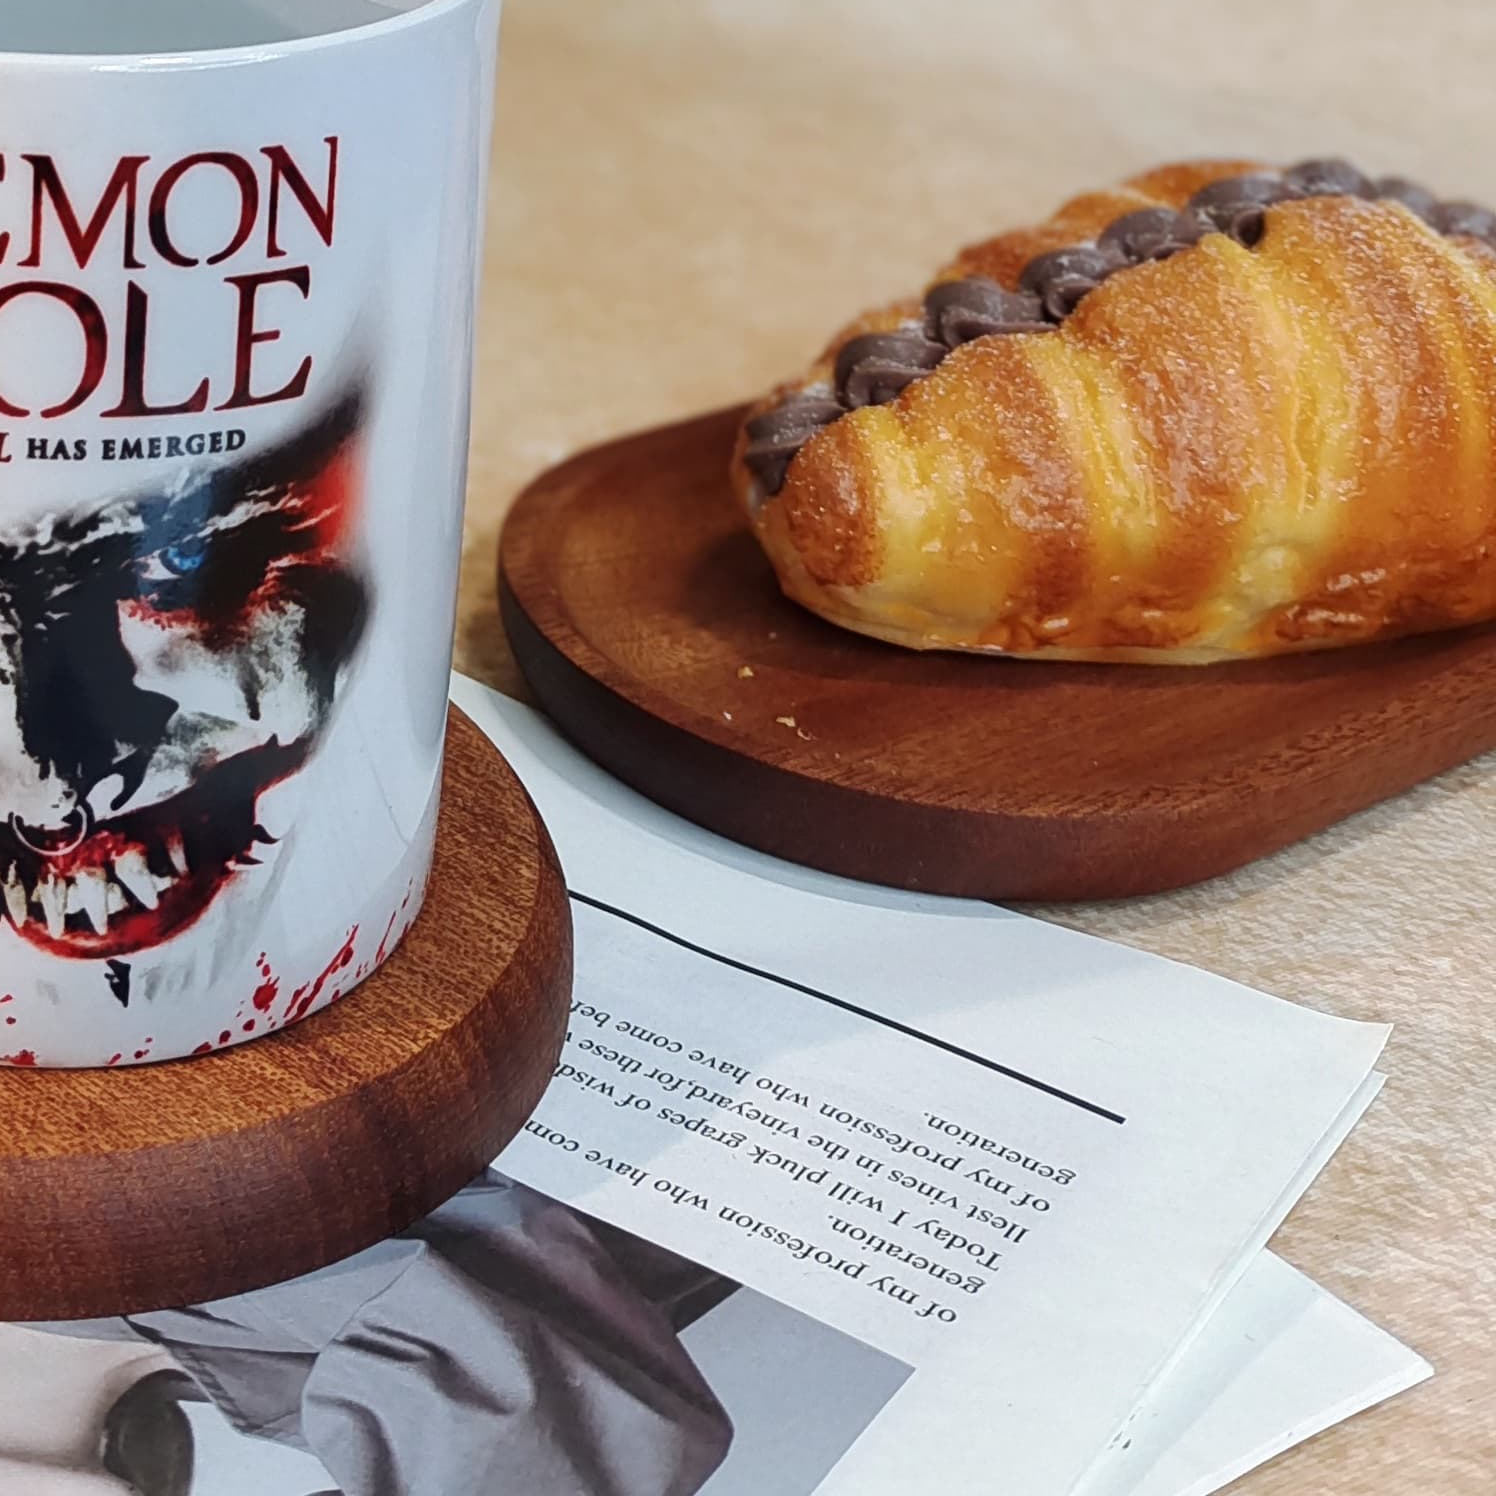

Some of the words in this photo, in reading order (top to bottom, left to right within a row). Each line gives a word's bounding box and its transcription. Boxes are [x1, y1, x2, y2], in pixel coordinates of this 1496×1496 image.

[26, 437, 87, 462] HAS
[101, 428, 246, 461] EMERGED
[615, 1020, 684, 1054] come
[579, 1038, 643, 1074] these
[688, 1049, 752, 1085] have
[614, 1092, 652, 1112] of
[755, 1077, 810, 1109] who
[656, 1106, 748, 1150] grapes
[819, 1102, 964, 1171] profession
[747, 1143, 832, 1185] pluck
[807, 1134, 850, 1161] the
[924, 1112, 1077, 1187] generation.
[585, 1149, 651, 1187] have
[855, 1153, 885, 1178] in
[964, 1168, 1015, 1196] my
[654, 1178, 710, 1212] who
[826, 1180, 885, 1213] will
[888, 1169, 959, 1210] vines
[1009, 1191, 1050, 1212] of
[888, 1208, 910, 1227] I
[718, 1205, 870, 1281] profession
[828, 1214, 986, 1295] generation.
[912, 1218, 1003, 1272] Today
[867, 1275, 921, 1306] my
[914, 1301, 958, 1324] of
